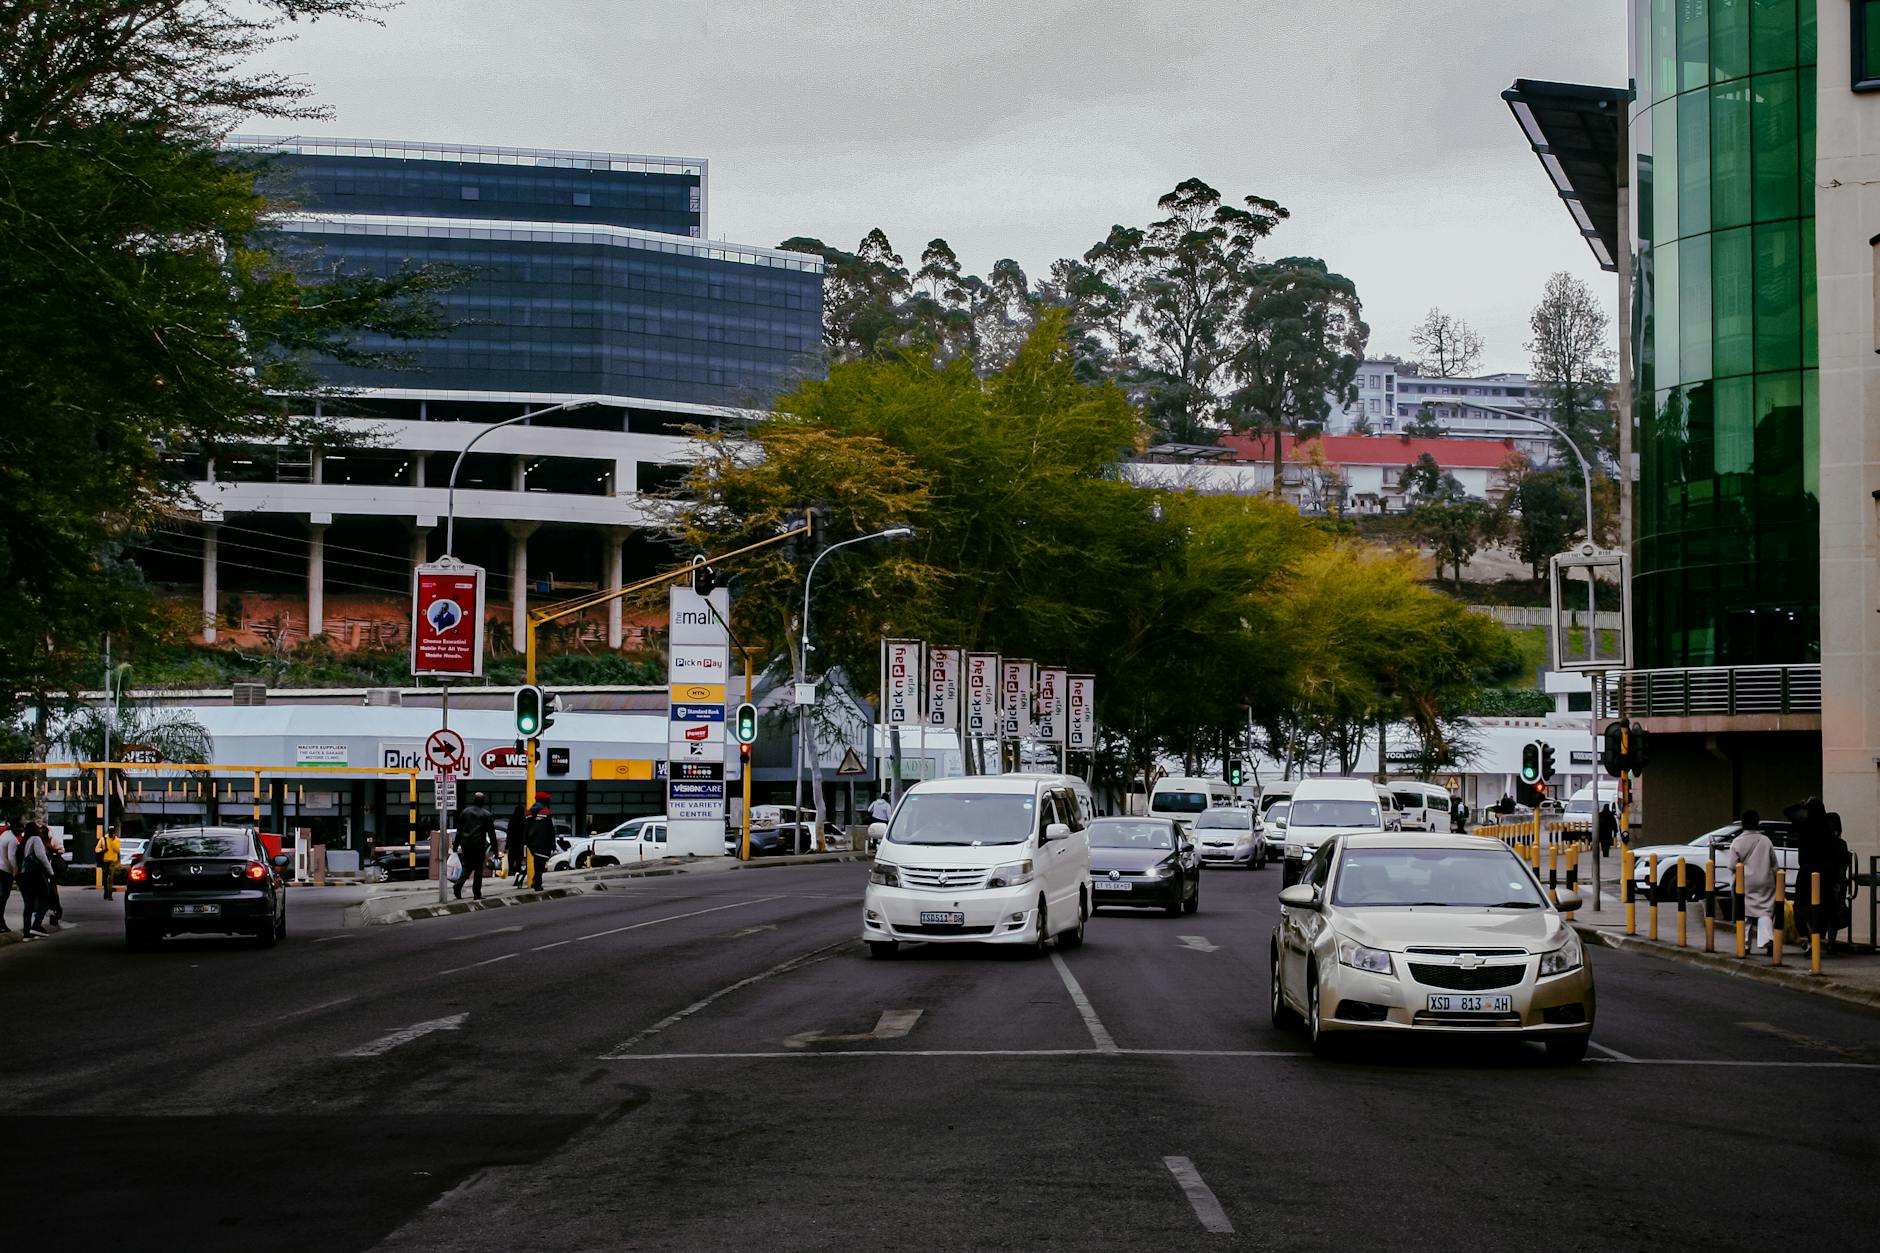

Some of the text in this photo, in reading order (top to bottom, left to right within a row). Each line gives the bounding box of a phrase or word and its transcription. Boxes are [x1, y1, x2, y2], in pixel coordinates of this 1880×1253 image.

[682, 609, 715, 625] mall
[676, 657, 696, 667] Pick
[703, 659, 723, 668] Pay
[892, 647, 906, 721] Pick n Pay
[932, 653, 947, 724] Pick n Pay
[1007, 666, 1020, 692] Pay
[1043, 674, 1055, 699] Pay
[971, 660, 985, 728] Pick n Pay
[1072, 682, 1084, 707] Pay
[1006, 705, 1018, 732] Pick
[1042, 711, 1053, 737] Pick
[1072, 718, 1082, 743] Pick
[384, 749, 421, 774] Pick
[486, 753, 528, 766] PWE
[1430, 996, 1508, 1011] XSD 813 AH
